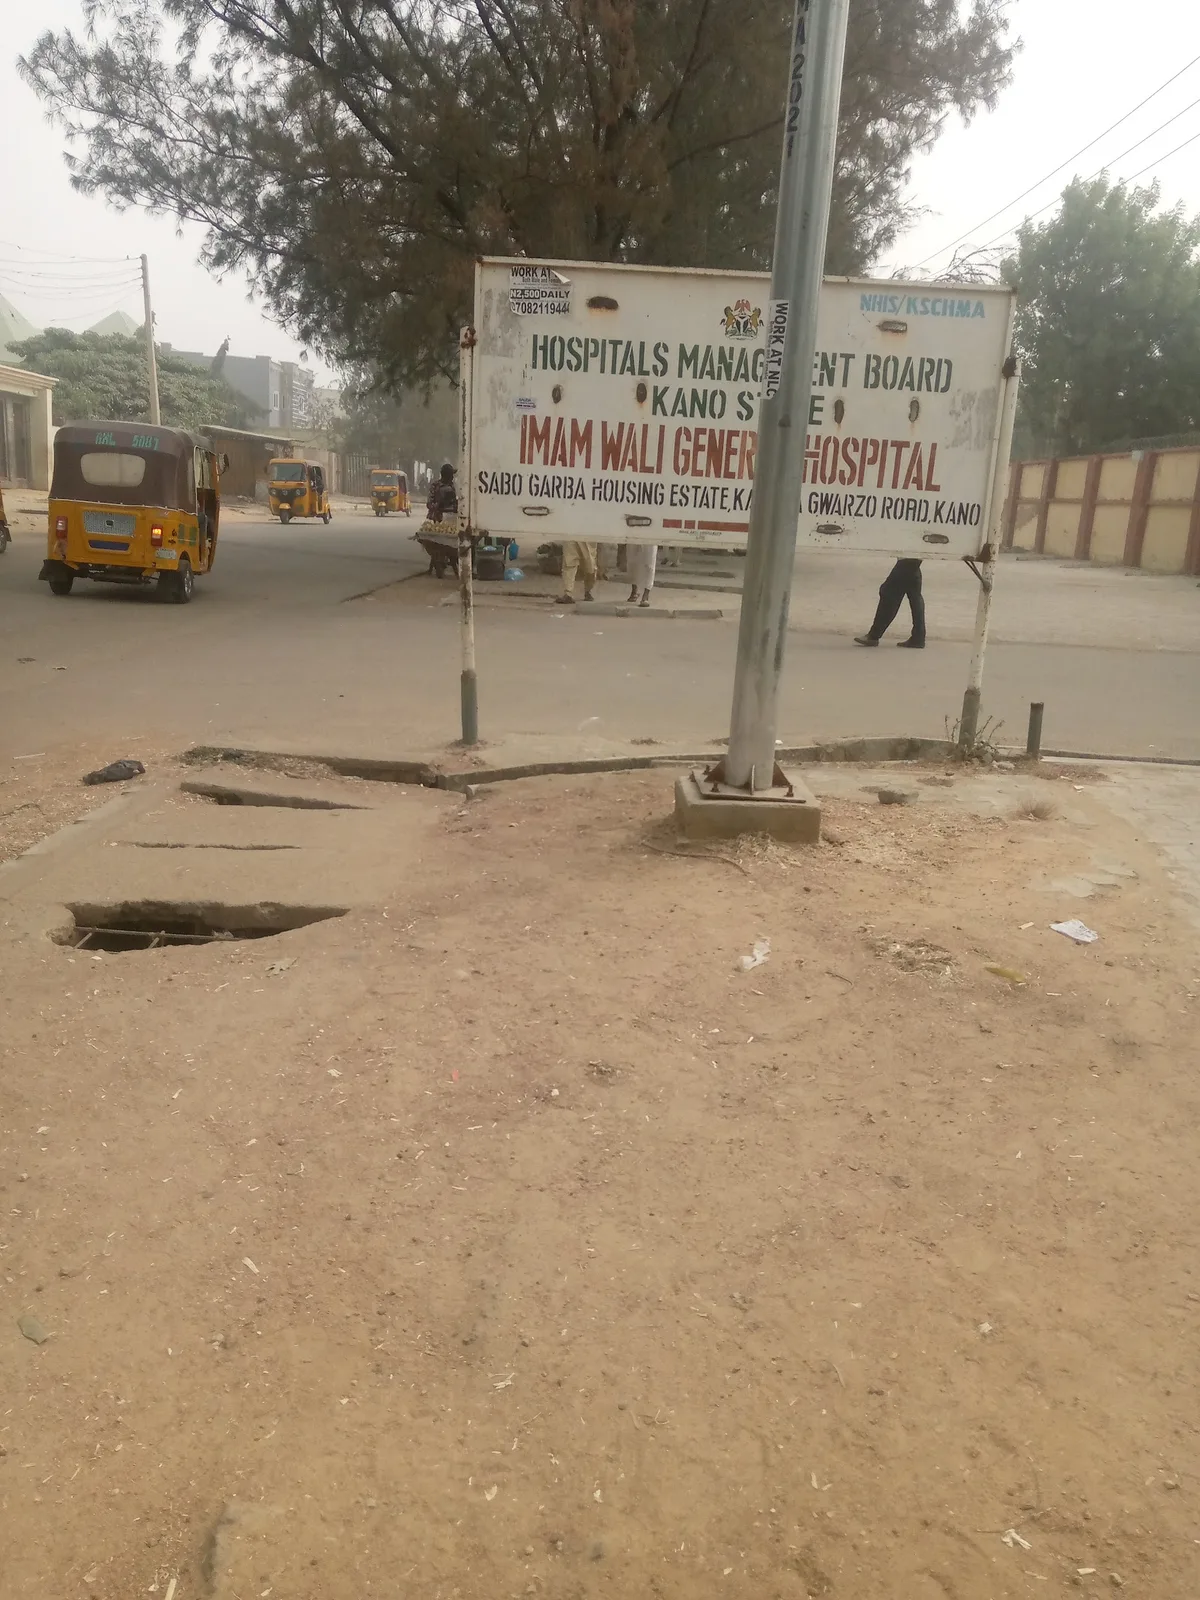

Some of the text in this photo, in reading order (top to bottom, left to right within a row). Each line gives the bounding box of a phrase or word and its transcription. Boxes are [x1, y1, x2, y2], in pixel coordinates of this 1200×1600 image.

[787, 53, 806, 158] 2021
[511, 267, 538, 277] WORK
[771, 302, 788, 344] WORK
[860, 294, 985, 318] NHIS/KSCHMA
[531, 334, 953, 393] HOSPITALS MANAGNT BOARD
[768, 349, 782, 366] AT
[652, 385, 726, 419] KANO
[519, 414, 941, 491] IMAM WALI GENER HOSPITAL
[478, 470, 522, 496] SABO
[528, 474, 586, 500] GARBA
[592, 478, 664, 506] HOUSING
[808, 491, 876, 517] GWARZO
